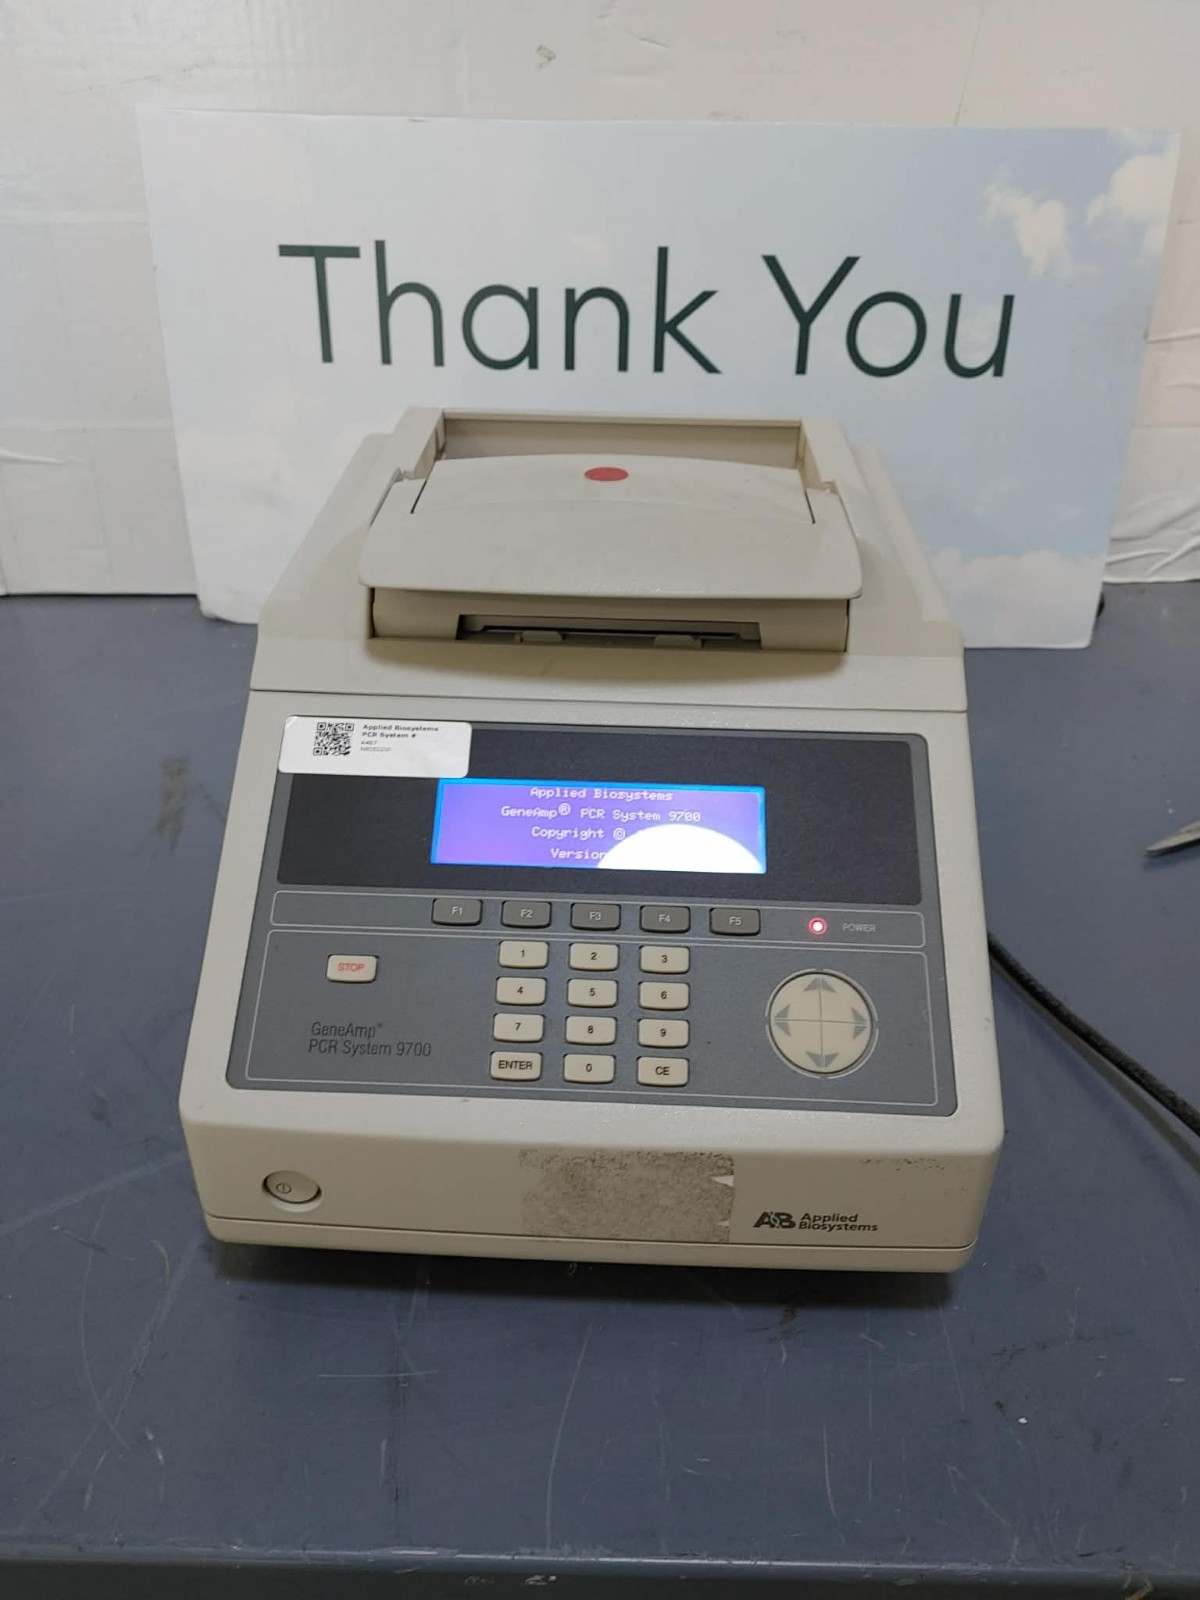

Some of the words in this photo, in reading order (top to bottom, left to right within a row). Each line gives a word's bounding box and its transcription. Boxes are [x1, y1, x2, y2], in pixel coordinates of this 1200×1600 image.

[278, 240, 722, 375] Thank
[761, 254, 1016, 379] You
[529, 787, 587, 799] Applied
[593, 789, 674, 802] Biosystems
[580, 808, 606, 820] PCR
[612, 810, 661, 822] System
[668, 811, 701, 823] 9700
[531, 825, 605, 840] Copyright
[451, 906, 464, 916] F1
[520, 908, 533, 918] F2
[589, 911, 602, 921] F3
[658, 913, 672, 923] F4
[729, 916, 742, 926] F5
[842, 923, 876, 932] POWER
[520, 949, 526, 958] 1
[590, 951, 598, 961] 2
[660, 954, 668, 964] 3
[337, 962, 365, 972] STOP
[516, 986, 524, 995] 4
[588, 987, 596, 997] 5
[659, 990, 667, 1000] 6
[514, 1022, 522, 1032] 7
[586, 1025, 594, 1035] 8
[659, 1028, 667, 1038] 9
[308, 1039, 338, 1054] PCR
[342, 1040, 391, 1058] System
[396, 1042, 431, 1057] 9700
[498, 1060, 533, 1071] ENTER
[585, 1063, 593, 1073] 0
[655, 1066, 671, 1076] CE
[800, 1213, 858, 1223] Applied
[798, 1221, 878, 1232] Biosystems
